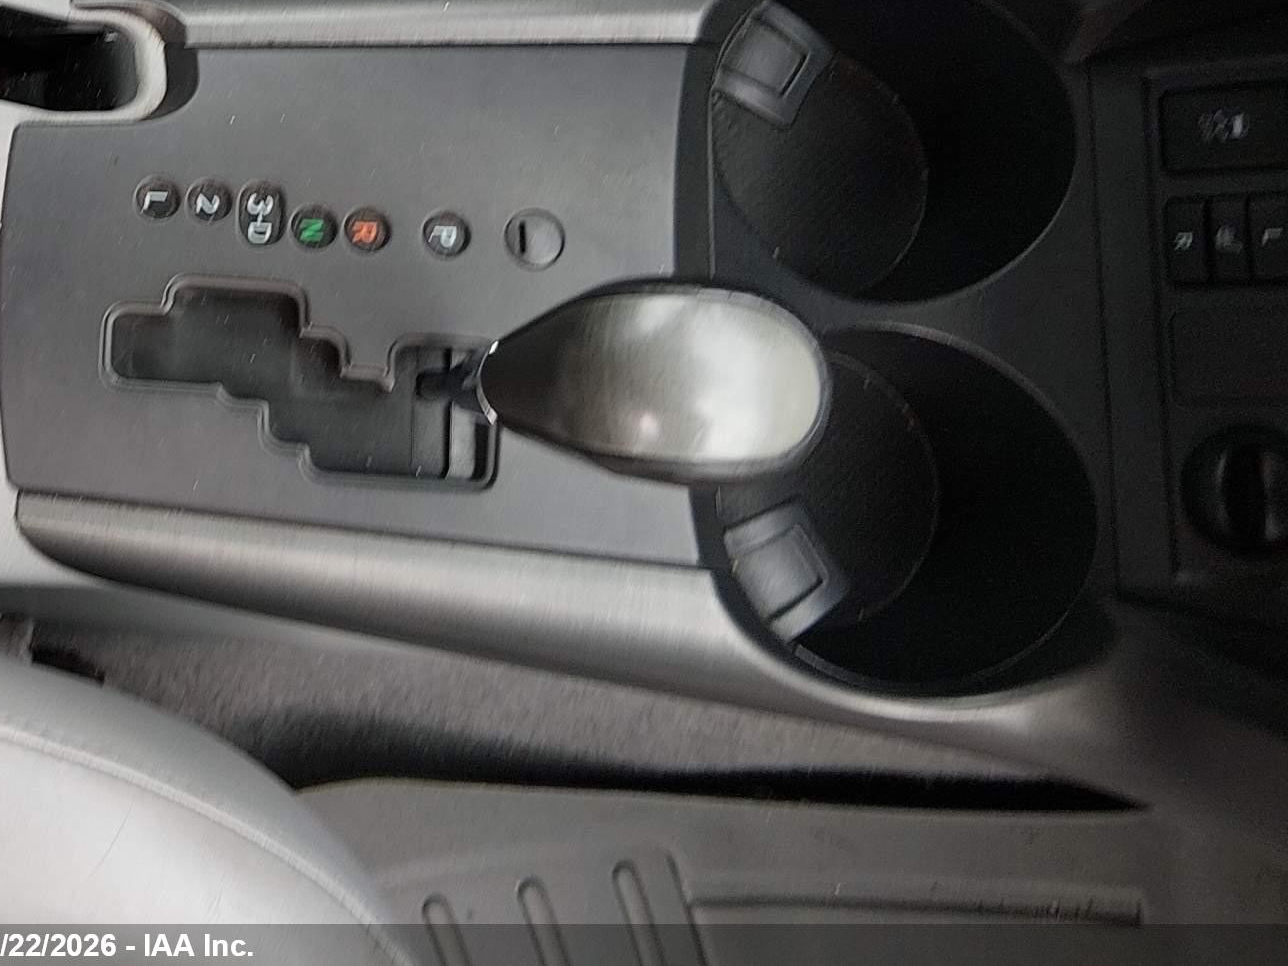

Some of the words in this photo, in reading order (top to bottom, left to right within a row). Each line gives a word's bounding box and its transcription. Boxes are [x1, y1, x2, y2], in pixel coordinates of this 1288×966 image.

[142, 191, 168, 212] L
[196, 192, 220, 214] 2
[300, 218, 324, 242] N
[352, 220, 378, 243] R
[428, 226, 457, 248] P
